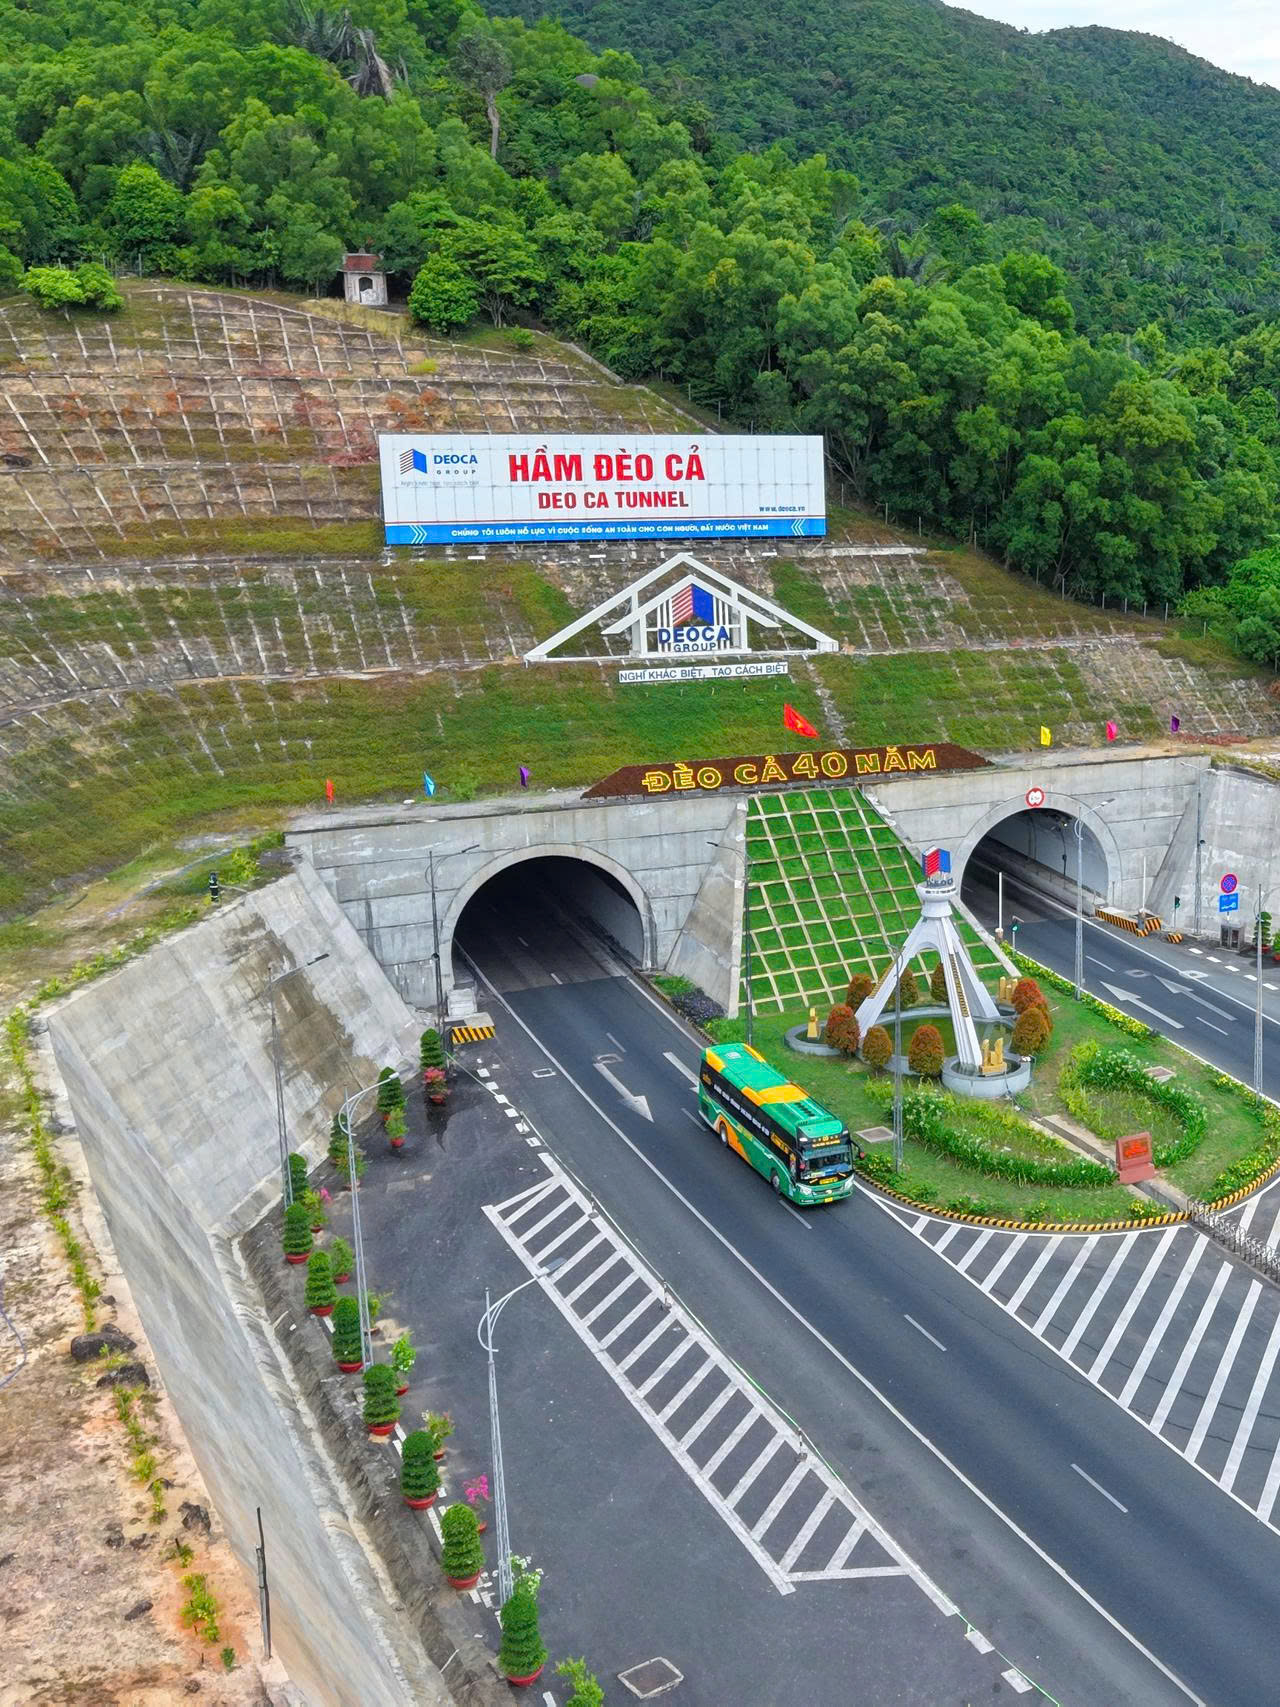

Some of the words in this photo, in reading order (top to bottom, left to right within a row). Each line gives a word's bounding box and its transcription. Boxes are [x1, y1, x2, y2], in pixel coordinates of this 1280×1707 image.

[433, 454, 478, 465] DEOCA
[508, 444, 583, 482] HẦM
[593, 447, 654, 482] ĐÈO
[664, 444, 706, 482] CẢ
[537, 491, 577, 510] DEO
[583, 491, 610, 509] CA
[614, 490, 690, 508] TUNNEL
[604, 526, 616, 534] AN
[656, 525, 673, 533] CON
[752, 523, 769, 532] NAM
[658, 625, 730, 644] DEOCA
[673, 642, 717, 652] GROUP
[648, 668, 678, 680] KHÁC
[735, 663, 764, 676] CÁCH
[766, 662, 787, 675] BIỆT
[641, 762, 723, 793] ĐÈO
[734, 755, 788, 785] CẢ
[792, 751, 849, 779] 40
[855, 746, 938, 774] NĂM
